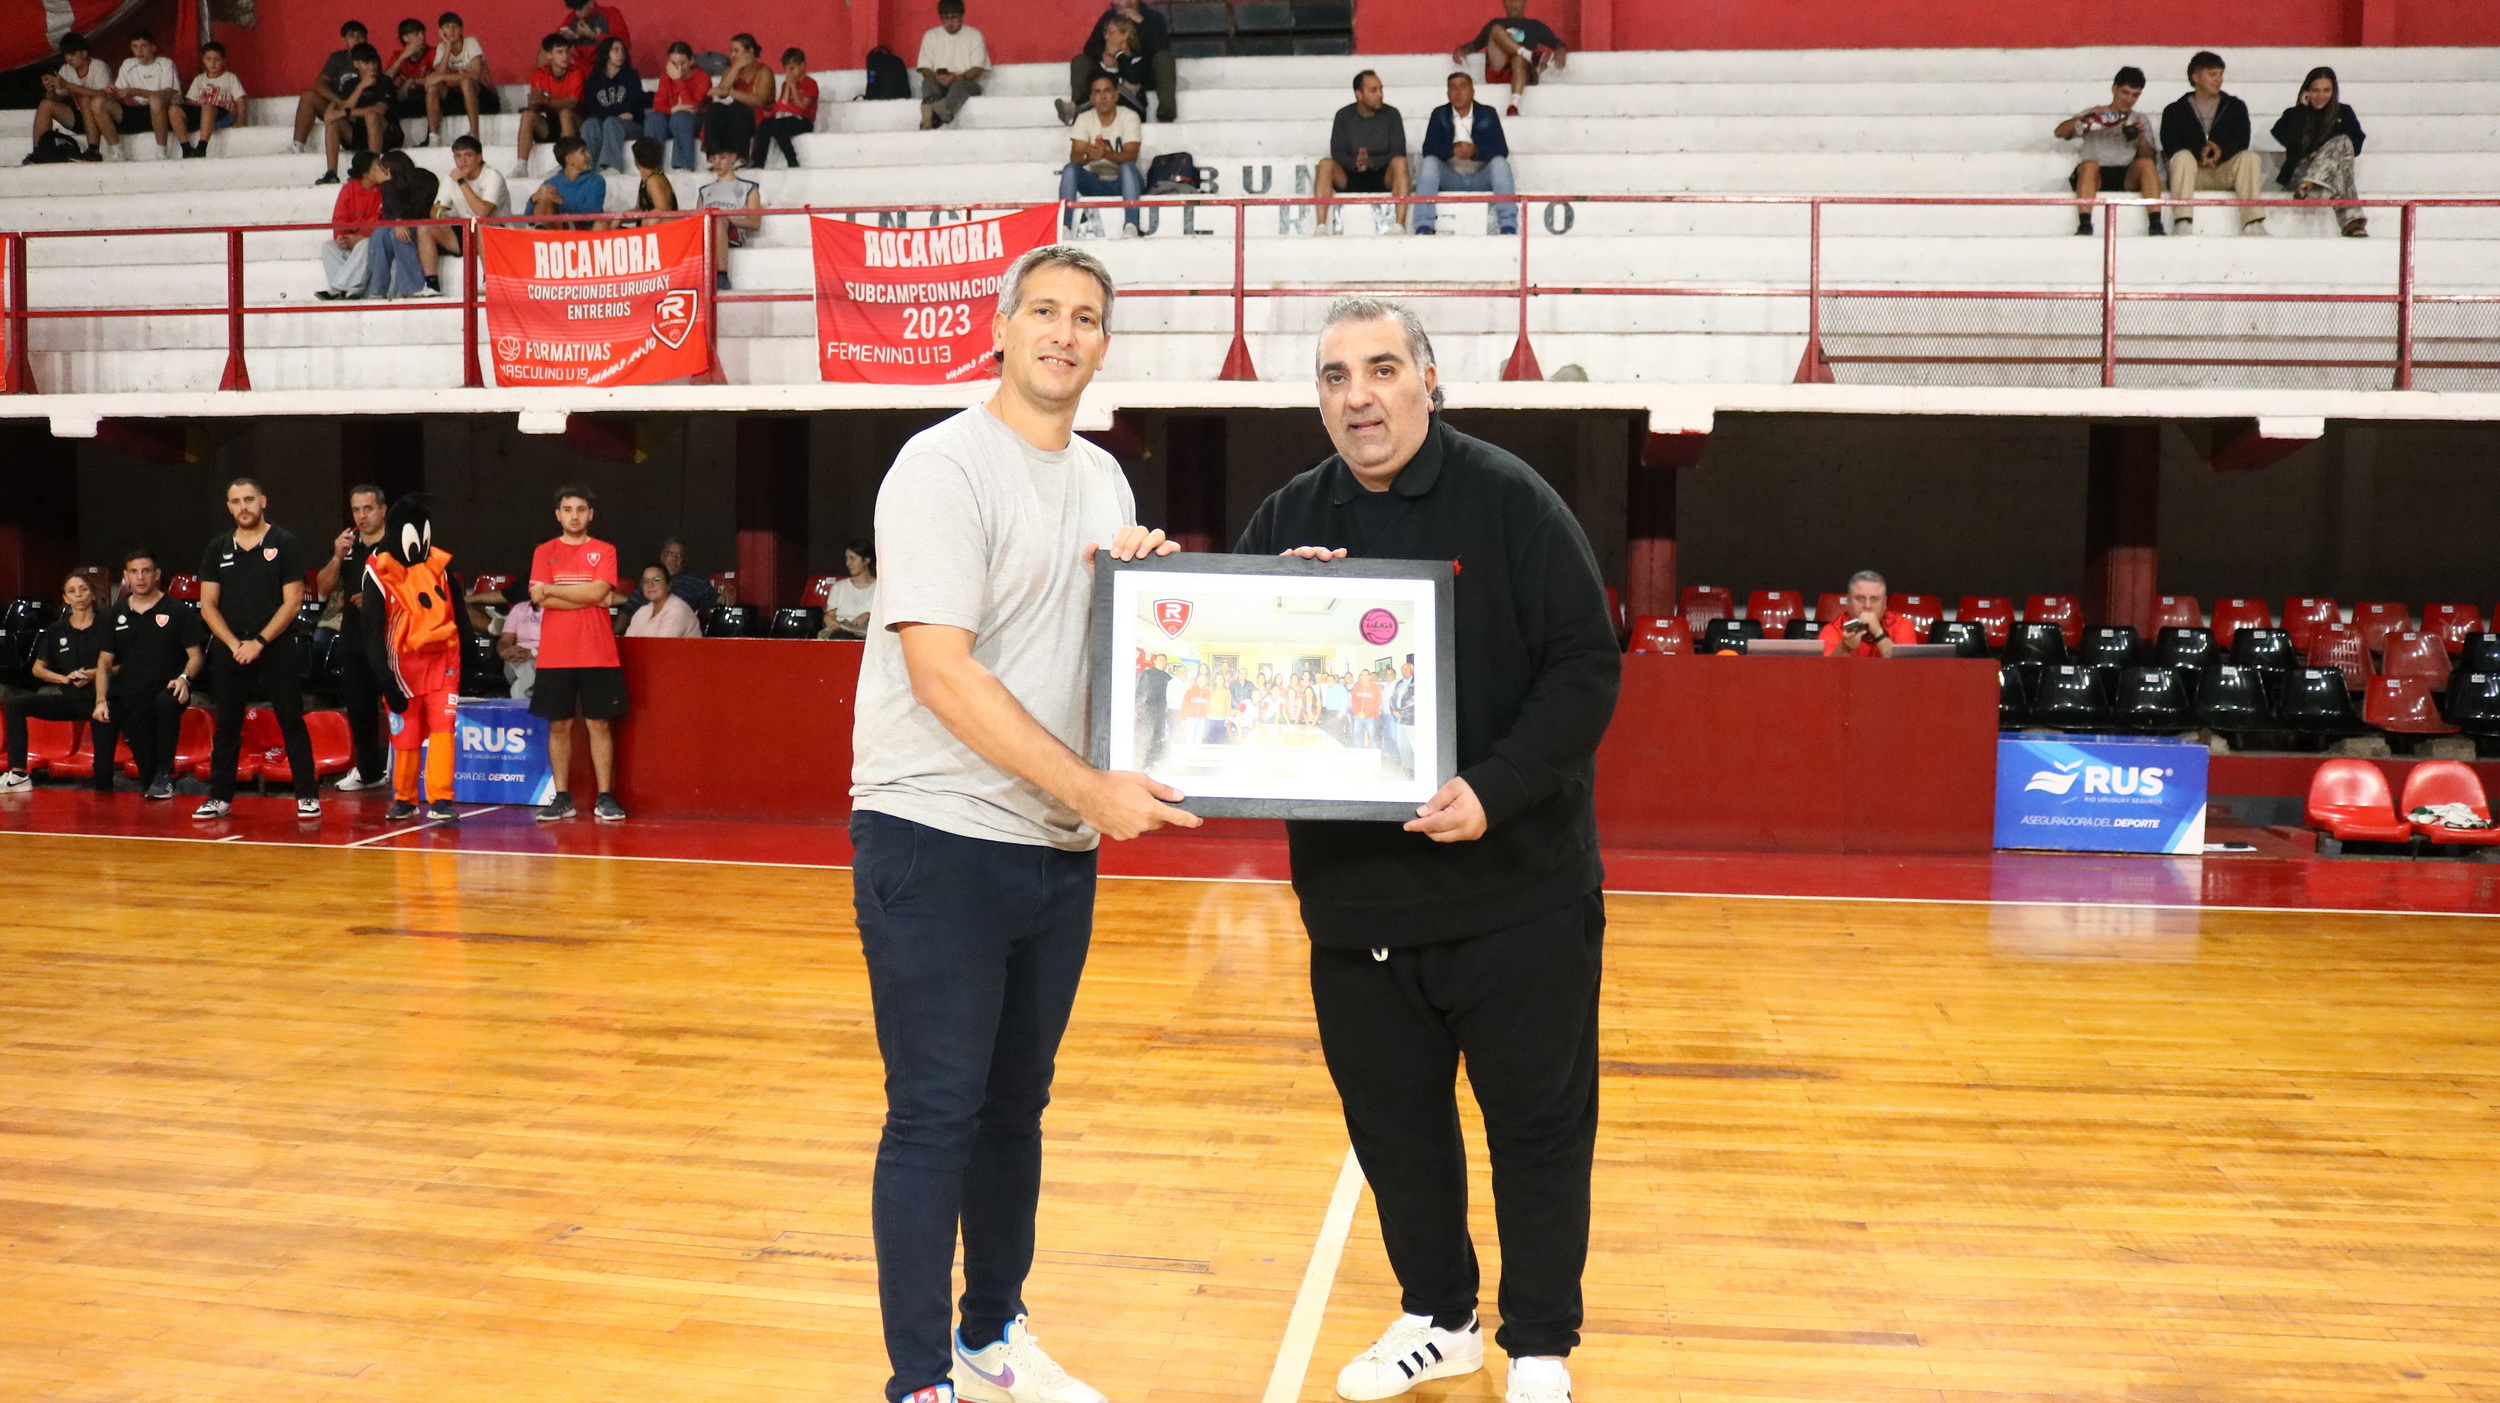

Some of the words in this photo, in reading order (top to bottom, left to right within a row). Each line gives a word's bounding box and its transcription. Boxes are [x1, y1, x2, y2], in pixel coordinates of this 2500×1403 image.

[864, 221, 1004, 268] ROCAMORA
[534, 233, 661, 279] ROCAMORA
[527, 284, 599, 301] CONCEPCION
[620, 274, 670, 297] URUGUAY
[902, 304, 971, 339] 2023
[526, 341, 611, 362] FORMATIVAS
[827, 342, 914, 365] FEMENINO
[499, 363, 564, 380] MASCULINO
[945, 359, 976, 380] VAMOS
[1165, 603, 1182, 618] R
[473, 773, 488, 781] DEL
[488, 773, 526, 782] DEPORTE
[2131, 797, 2163, 805] SEGUROS
[2020, 815, 2092, 827] ASEGURADORA
[2094, 817, 2112, 827] DEL
[2113, 818, 2160, 828] DEPORTE
